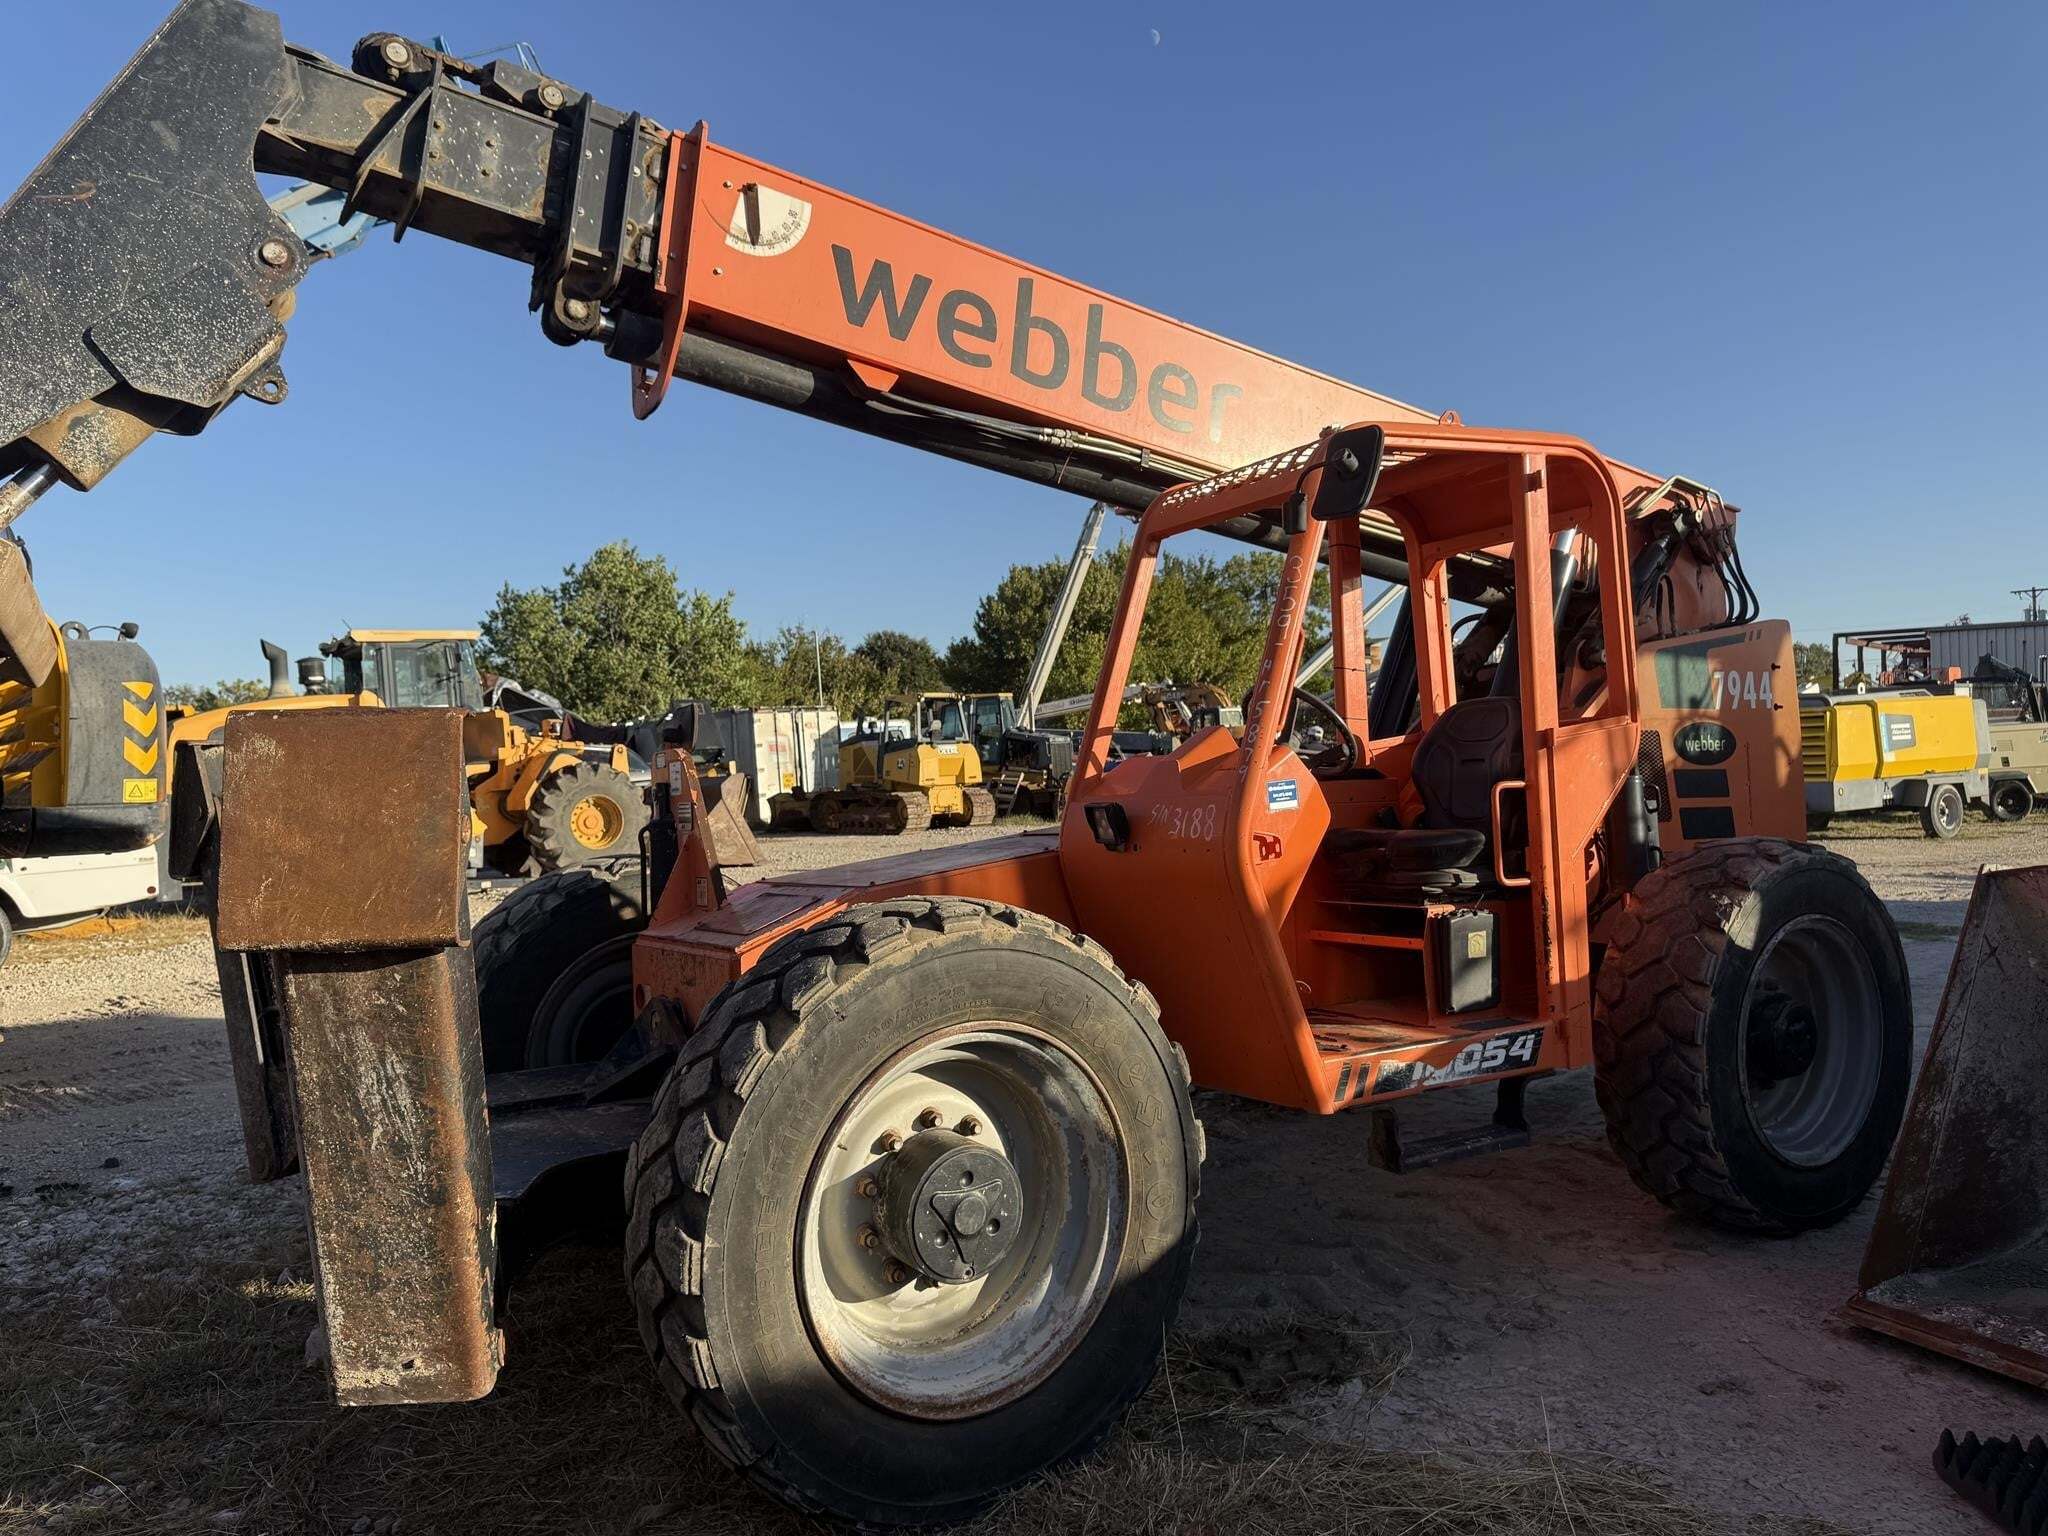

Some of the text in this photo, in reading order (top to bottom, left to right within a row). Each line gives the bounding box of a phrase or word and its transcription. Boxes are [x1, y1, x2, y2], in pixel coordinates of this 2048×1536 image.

[830, 243, 1243, 444] webber
[1712, 670, 1773, 711] 7944
[1684, 735, 1727, 753] webber
[1168, 804, 1215, 841] 3188
[1037, 976, 1176, 1312] Fireston
